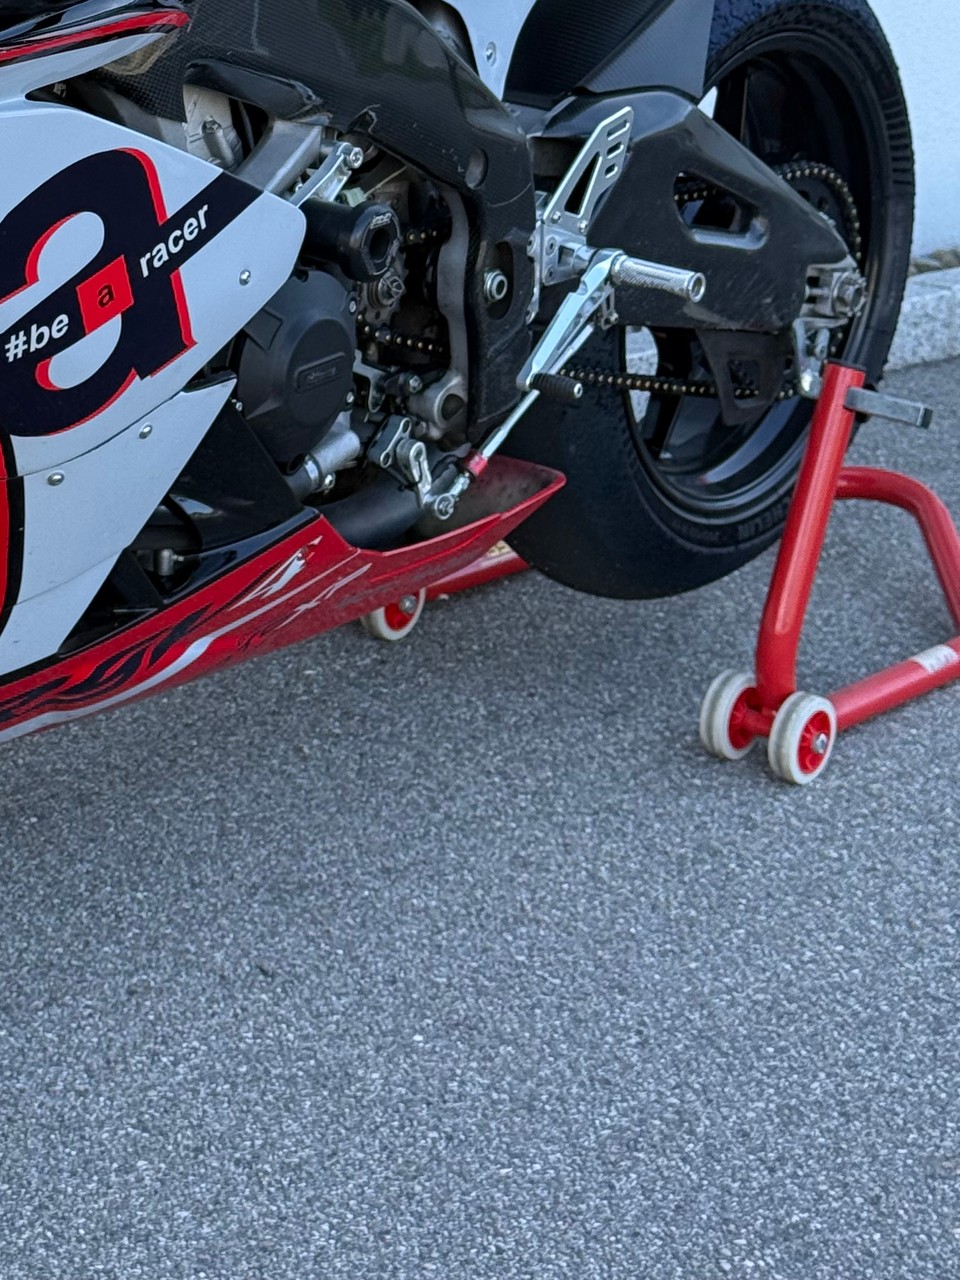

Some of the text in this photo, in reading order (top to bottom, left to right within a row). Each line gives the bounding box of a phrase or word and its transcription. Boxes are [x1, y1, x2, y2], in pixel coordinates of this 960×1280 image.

[4, 204, 210, 363] #be a racer
